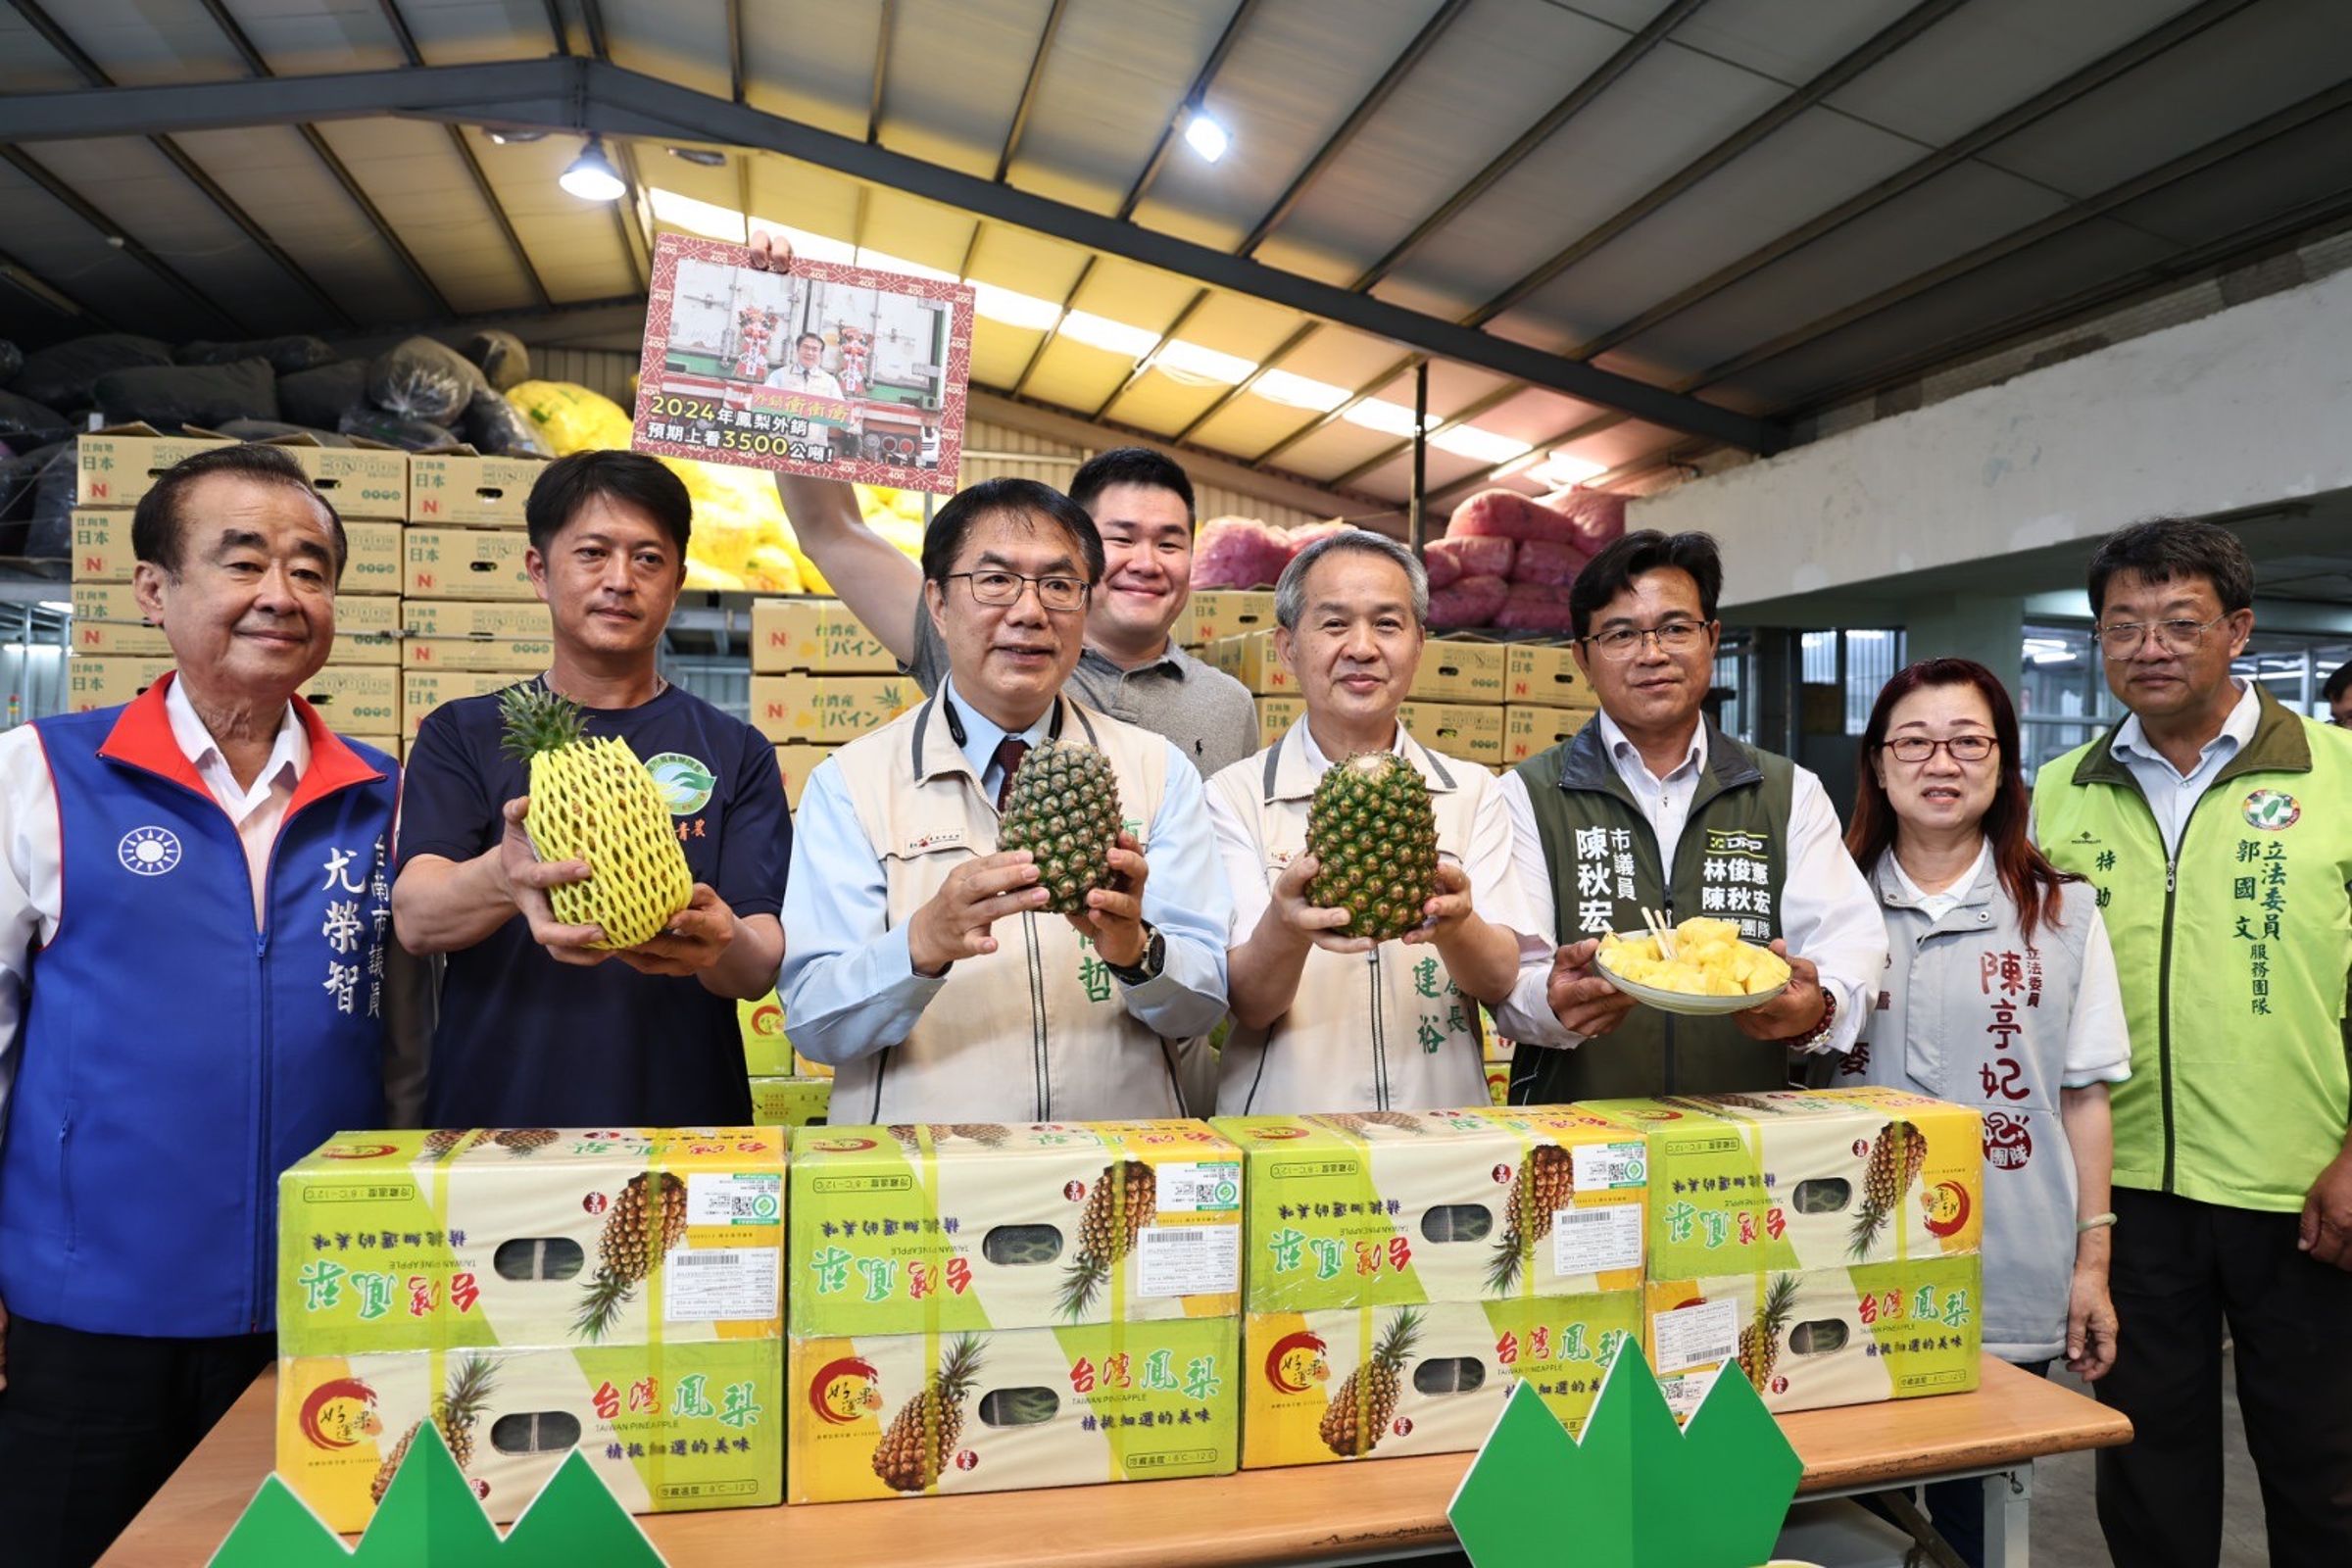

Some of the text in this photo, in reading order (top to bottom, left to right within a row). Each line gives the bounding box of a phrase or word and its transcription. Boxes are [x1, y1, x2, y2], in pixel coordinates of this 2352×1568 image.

[650, 395, 808, 437] 2024年鳳梨外銷
[82, 456, 114, 470] 日本
[416, 473, 445, 487] 日本
[77, 530, 109, 545] 日本
[410, 548, 439, 562] 日本
[76, 604, 108, 618] 日本
[771, 633, 786, 646] N
[73, 676, 104, 691] 日本
[409, 691, 438, 705] 日本
[768, 705, 783, 718] N
[1727, 836, 1763, 852] DPP
[1575, 825, 1614, 934] 陳秋宏
[1609, 827, 1638, 902] 市議員
[1703, 858, 1769, 885] 林俊憲
[2095, 849, 2117, 908] 特助
[1702, 887, 1771, 914] 陳秋宏
[2232, 839, 2261, 942] 郭國文
[2260, 840, 2287, 941] 立法委員
[321, 847, 367, 1015] 尤榮智
[2025, 948, 2043, 1008] 立法委員
[2250, 944, 2272, 1015] 服務團隊
[1979, 950, 2031, 1102] 陳亭妃
[1858, 1284, 1971, 1327] 台灣鳳梨
[1070, 1348, 1222, 1401] 台灣鳳梨
[592, 1374, 762, 1429] 台灣鳳梨
[629, 1420, 679, 1431] PINEAPPLE
